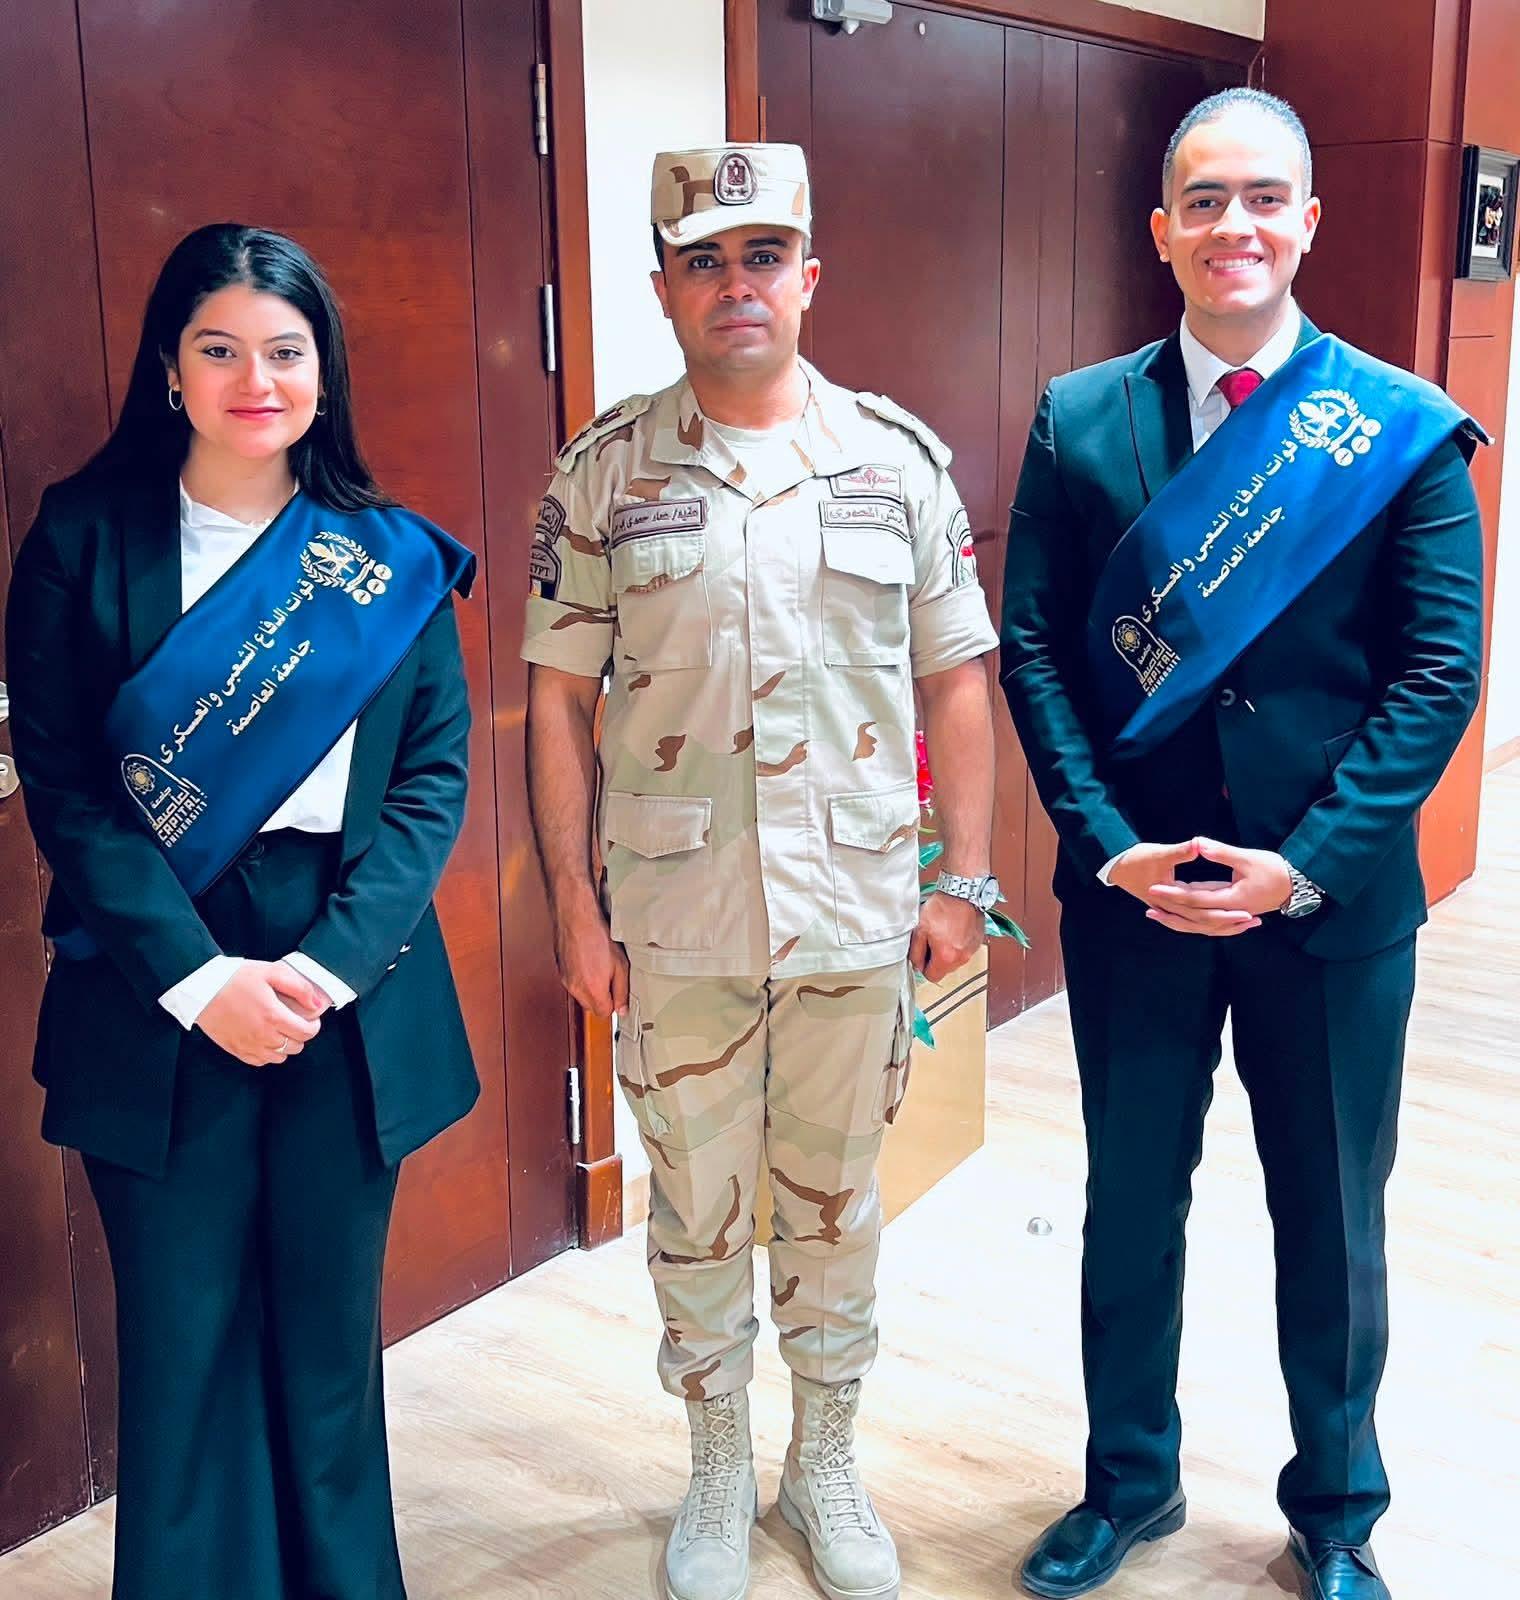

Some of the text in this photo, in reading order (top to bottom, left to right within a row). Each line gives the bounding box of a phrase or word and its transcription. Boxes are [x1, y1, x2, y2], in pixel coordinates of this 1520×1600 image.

[1265, 439, 1298, 476] قوات
[1230, 473, 1266, 517] الدفاع
[1198, 506, 1286, 598] جامعة العاصمة
[285, 578, 315, 612] قوات
[254, 607, 289, 649] الدفاع
[226, 639, 315, 736] جامعة العاصمة
[1142, 651, 1176, 692] CAPITAL
[157, 795, 200, 841] CAPITAL
[165, 801, 208, 847] UNIVERSITY
